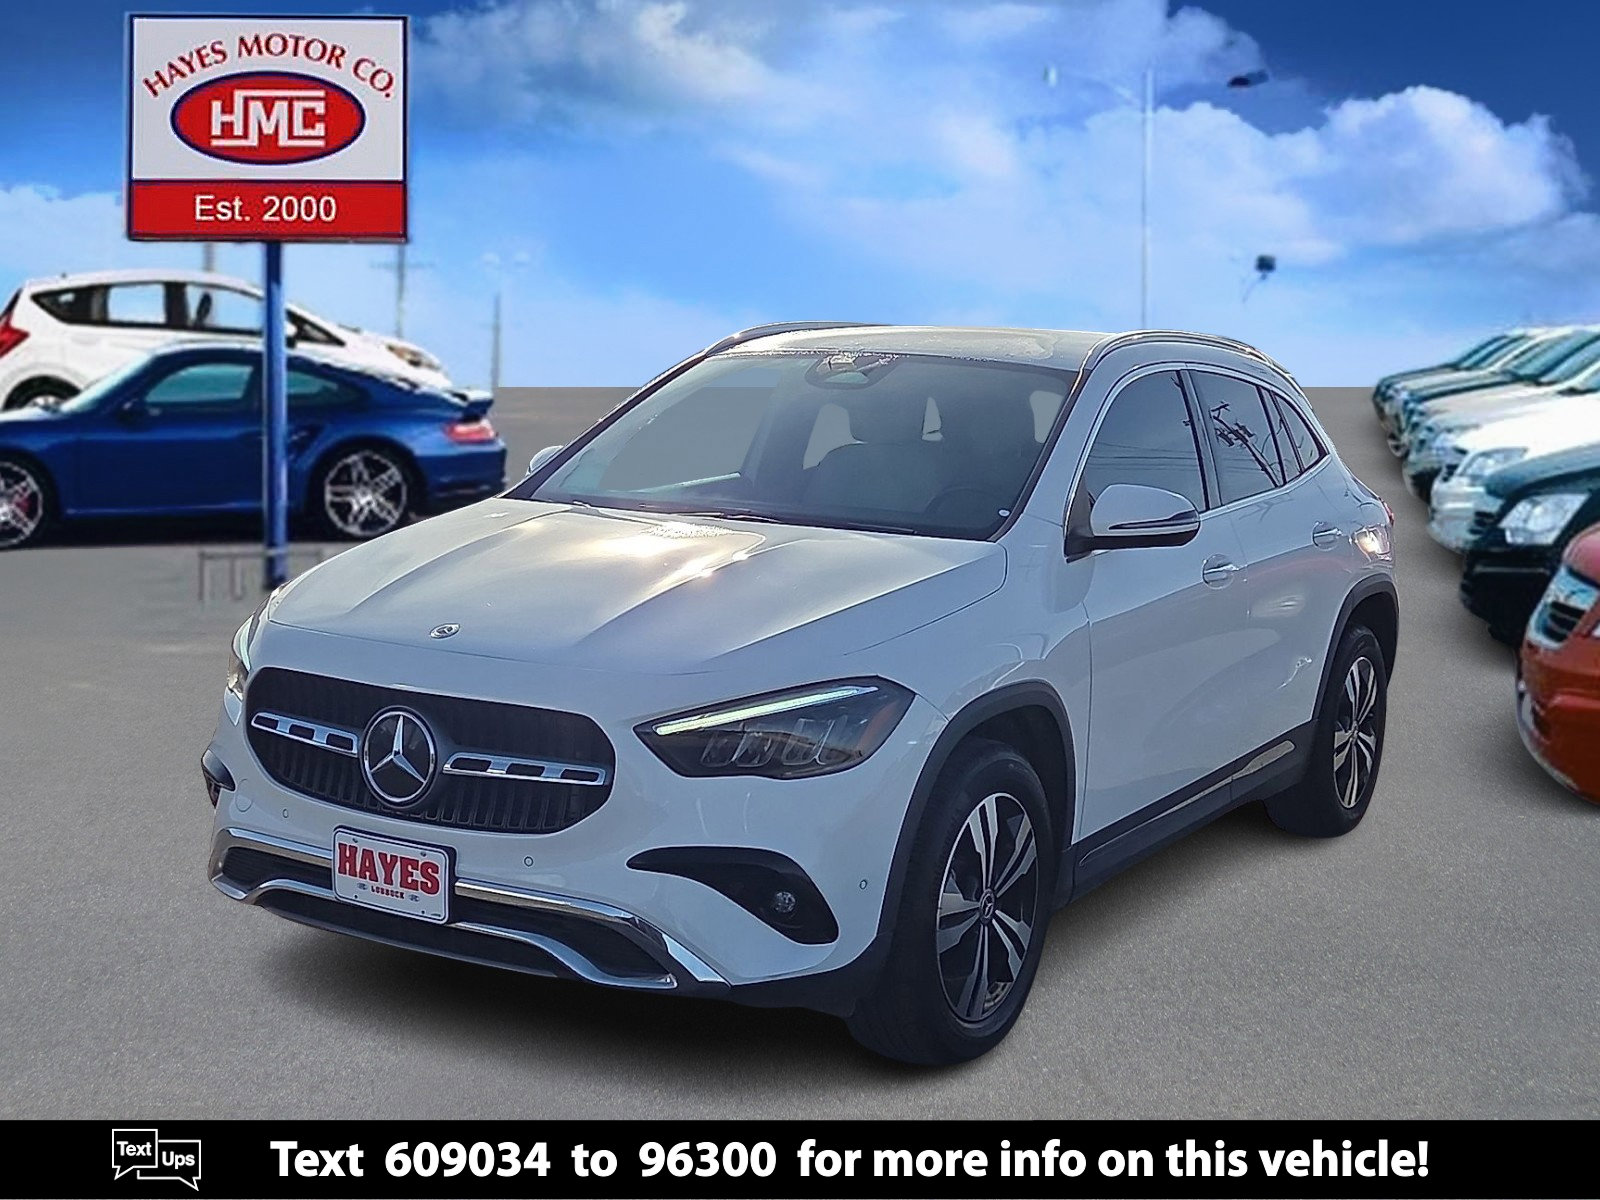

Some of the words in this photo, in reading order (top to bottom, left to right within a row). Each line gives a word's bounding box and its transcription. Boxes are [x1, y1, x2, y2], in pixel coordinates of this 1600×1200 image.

[142, 40, 228, 97] HAYES
[237, 33, 347, 69] MOTOR
[352, 57, 394, 98] CO.
[210, 89, 326, 147] HMC
[195, 195, 251, 221] Est.
[262, 195, 337, 221] 2000
[337, 842, 440, 895] HAYES
